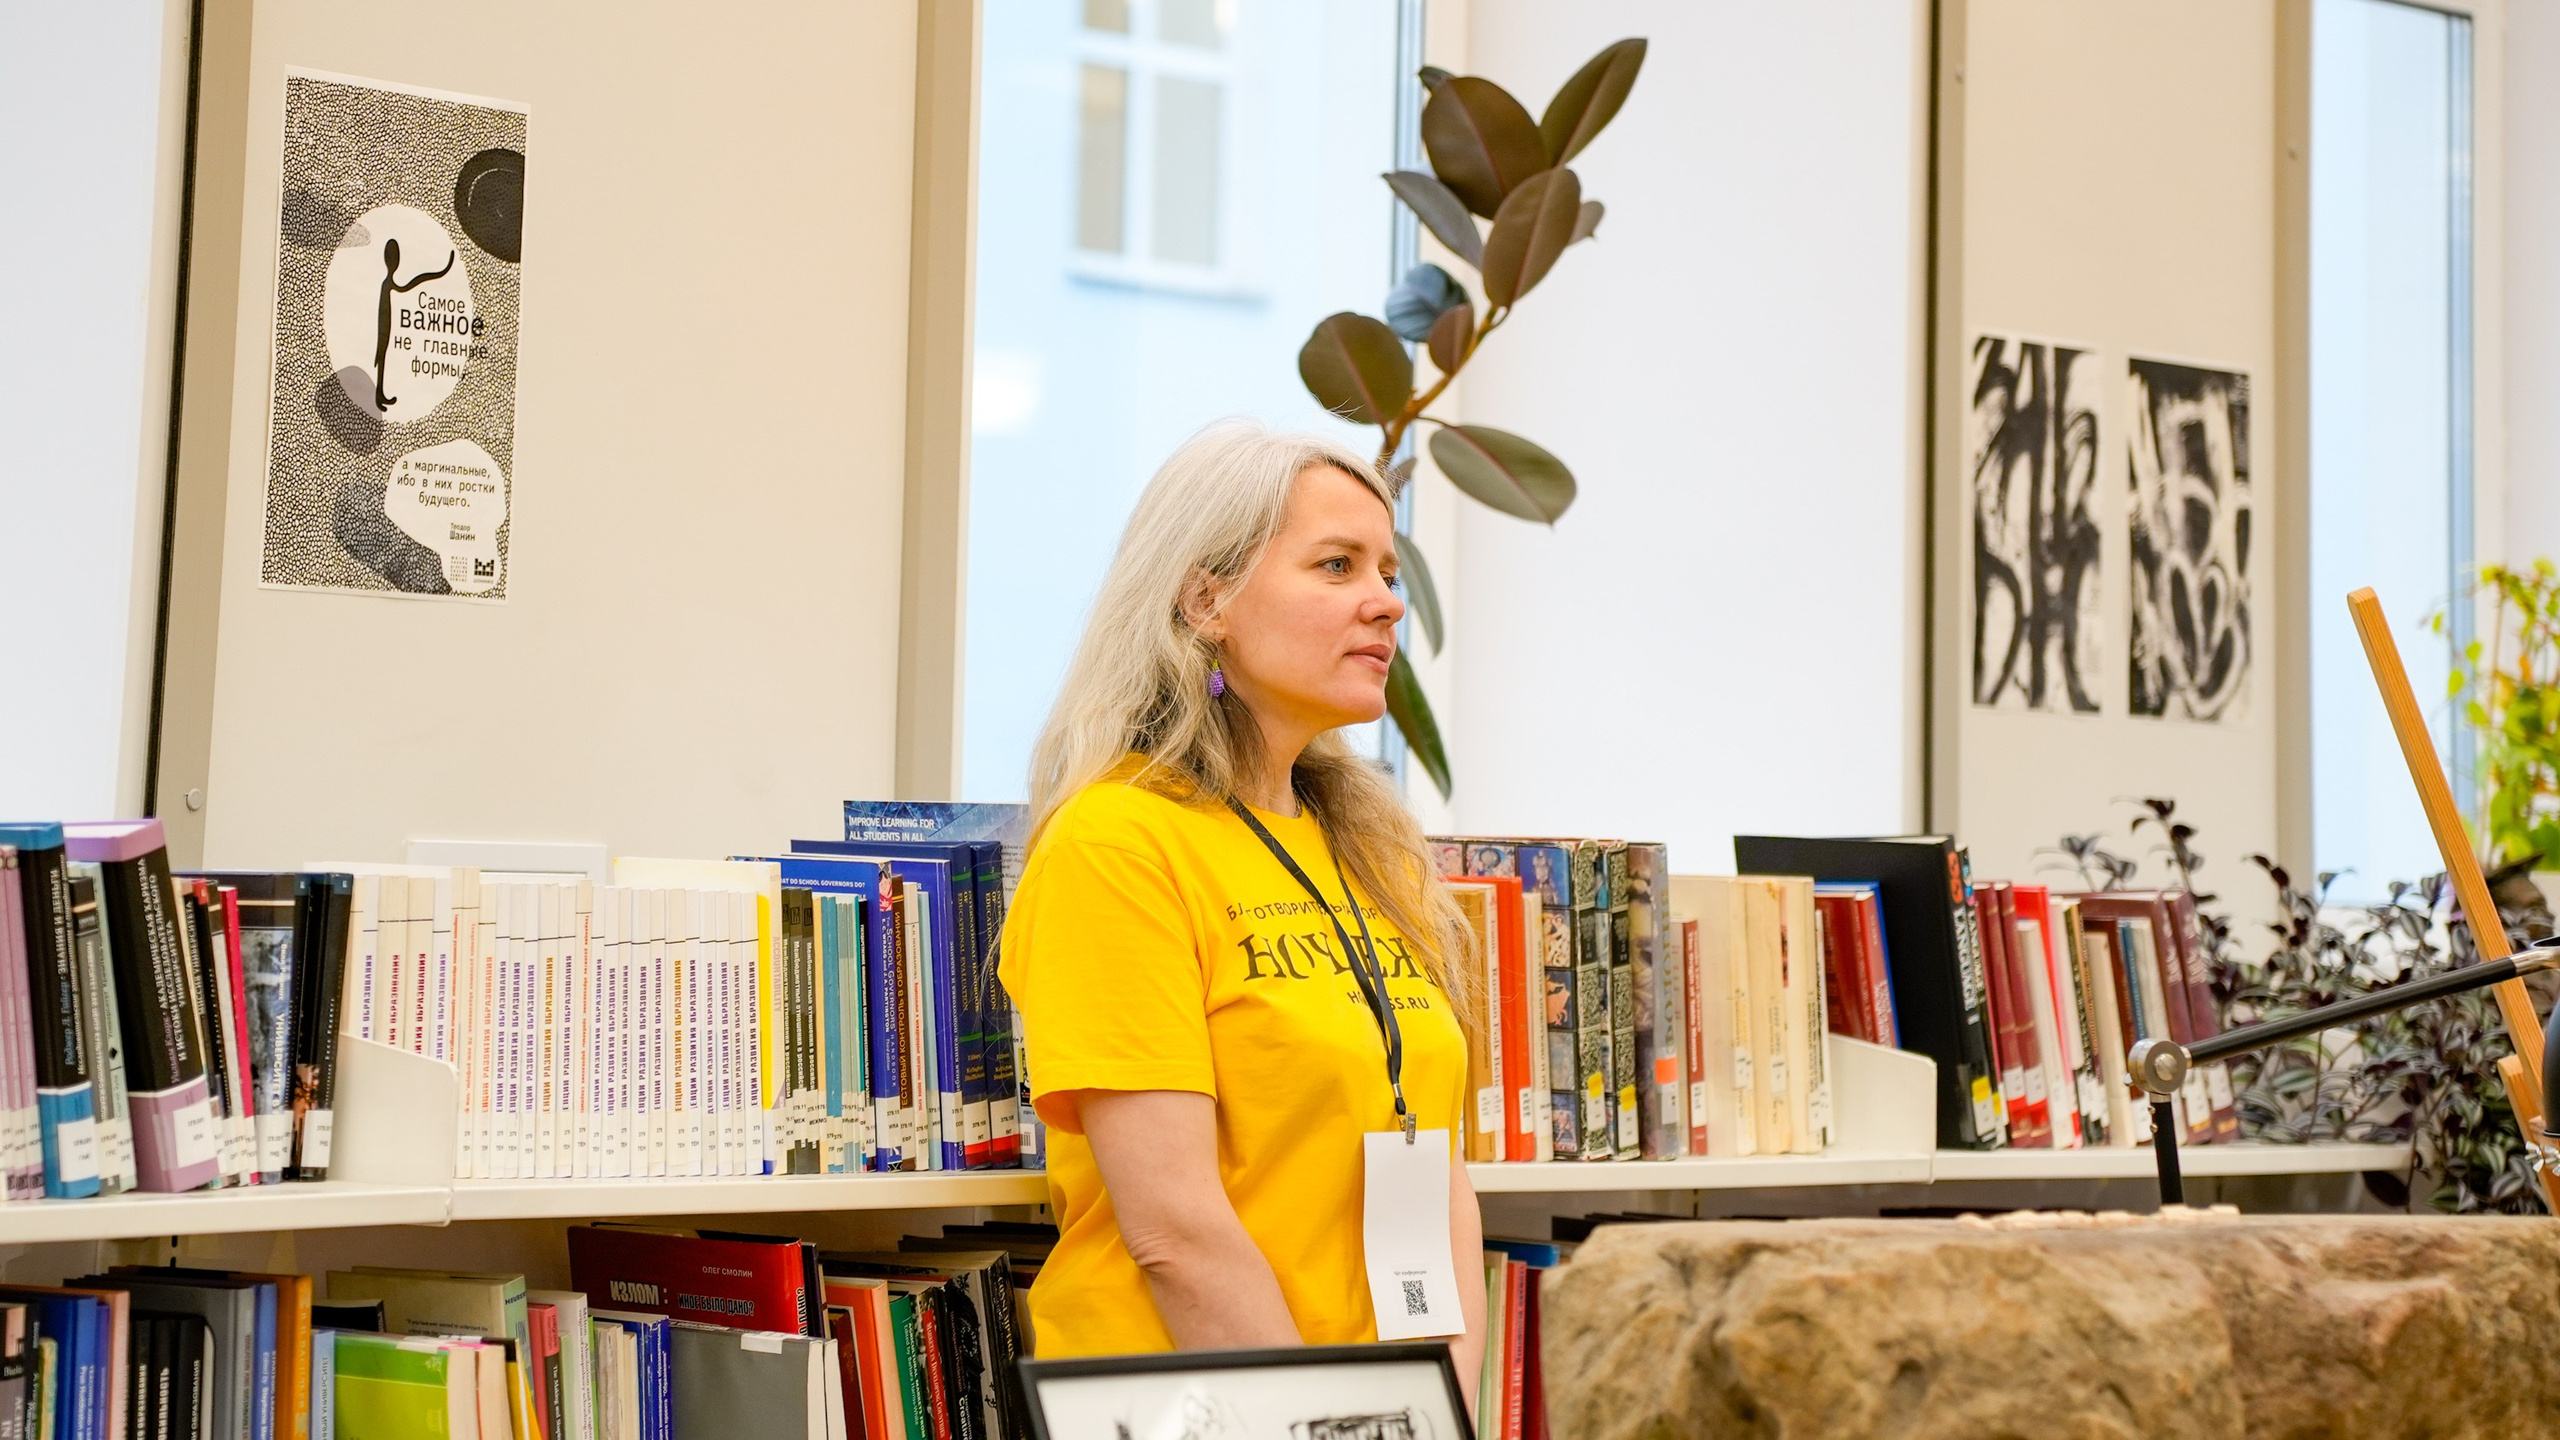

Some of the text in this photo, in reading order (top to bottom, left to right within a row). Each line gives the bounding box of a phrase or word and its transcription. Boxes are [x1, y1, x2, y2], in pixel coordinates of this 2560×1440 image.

[400, 308, 484, 336] важное
[418, 291, 465, 314] Самое
[394, 335, 488, 359] не главные
[411, 355, 466, 380] формы,
[397, 474, 495, 493] ибо в них ростки
[402, 460, 491, 479] а маргинальные,
[419, 491, 470, 508] будущего.
[450, 522, 471, 532] Теодор
[450, 530, 475, 541] Шанин
[848, 815, 935, 829] IMPROVE LEARNING FOR
[849, 831, 925, 842] ALL STUDENTS IN ALL
[50, 869, 61, 914] ДЕНЬГИ
[137, 858, 150, 912] ХАРИЗМА
[798, 878, 820, 886] SCHOOL
[821, 880, 853, 888] GOVERNORS
[963, 891, 969, 903] OF
[54, 916, 62, 925] И
[55, 928, 67, 974] ЗНАНИЯ
[185, 901, 201, 973] УНИВЕРСИТЕТА
[885, 928, 894, 969] SCHOOL
[893, 912, 904, 986] ОБРАЗОВАНИИ
[957, 893, 969, 1011] EDUCATIONAL EVALUATION
[967, 891, 975, 961] INTERNATIONAL
[1967, 909, 1985, 992] LANGUAGE
[146, 914, 167, 1009] АКАДЕМИЧЕСКАЯ
[149, 875, 185, 1050] ИСТОКИ ИССЛЕДОВАТЕЛЬСКОГО
[166, 921, 186, 1007] УНИВЕРСИТЕТА
[363, 955, 373, 1022] ОБРАЗОВАНИЯ
[390, 954, 400, 1023] ОБРАЗОВАНИЯ
[416, 953, 426, 1022] ОБРАЗОВАНИЯ
[437, 954, 446, 1019] ОБРАЗОВАНИЯ
[772, 937, 781, 1012] ACCOUNTABILITY
[782, 939, 790, 1001] Межбюджетные
[1953, 907, 1977, 1011] LANGUAGE
[482, 957, 493, 1078] РАЗВИТИЯ ОБРАЗОВАНИЯ
[510, 962, 521, 1079] РАЗВИТИЯ ОБРАЗОВАНИЯ
[542, 957, 554, 1078] РАЗВИТИЯ ОБРАЗОВАНИЯ
[674, 960, 683, 1078] РАЗВИТИЯ ОБРАЗОВАНИЯ
[706, 962, 714, 1076] РАЗВИТИЯ ОБРАЗОВАНИЯ
[748, 961, 758, 1073] РАЗВИТИЯ ОБРАЗОВАНИЯ
[793, 941, 803, 1045] Межбюджетные отношения
[806, 942, 816, 1047] Межбюджетные отношения
[887, 970, 897, 1032] GOVERNORS'
[1491, 967, 1501, 1049] Russian Folk
[272, 1013, 285, 1095] УНИВЕРСИТЕТ
[608, 968, 616, 1083] РАЗВИТИЯ ОБРАЗОВАНИЯ
[896, 1000, 906, 1053] КОНТРОЛЬ
[702, 1265, 753, 1278] ОЛЕГ СМОЛИН
[678, 1293, 755, 1317] ИНОЕ БЫЛО ДАНО?
[903, 1323, 911, 1346] Edited
[261, 1375, 268, 1384] by
[905, 1347, 912, 1355] by
[907, 1357, 916, 1381] Barbara
[907, 1323, 919, 1377] AGRICULTURAL
[914, 1379, 923, 1415] MARKETS
[926, 1321, 946, 1439] MARKETS IN DEVELOPING COUNTRIES
[86, 1365, 94, 1406] TEACHING
[190, 1359, 200, 1429] ОБРАЗОВАНИЯ
[261, 1387, 269, 1425] Stephanie
[321, 1356, 329, 1414] УНИВЕРСИТЕТ
[579, 1344, 587, 1391] compulsory
[583, 1431, 588, 1440] in
[1511, 1367, 1522, 1431] THE STUDY
